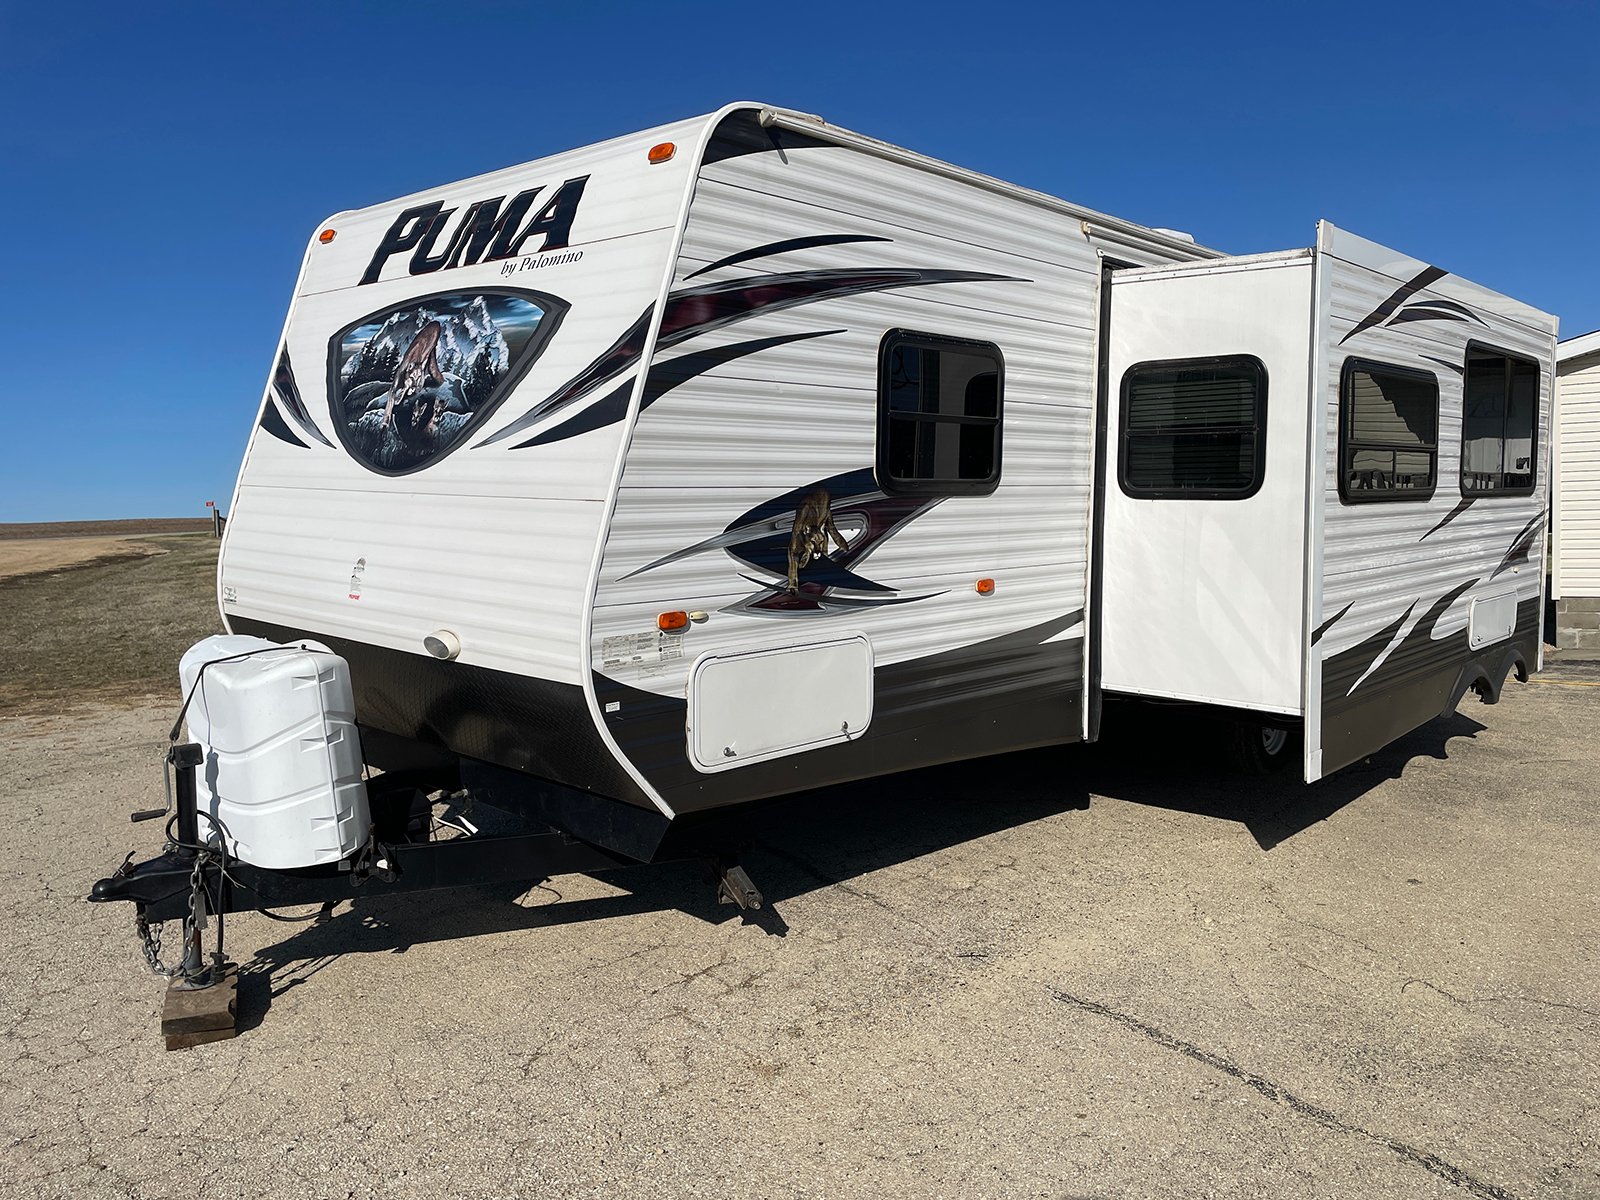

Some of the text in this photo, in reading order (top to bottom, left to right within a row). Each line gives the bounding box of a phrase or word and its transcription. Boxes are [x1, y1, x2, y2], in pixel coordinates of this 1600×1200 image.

[357, 174, 591, 286] PUMA
[500, 250, 584, 278] by Palomino
